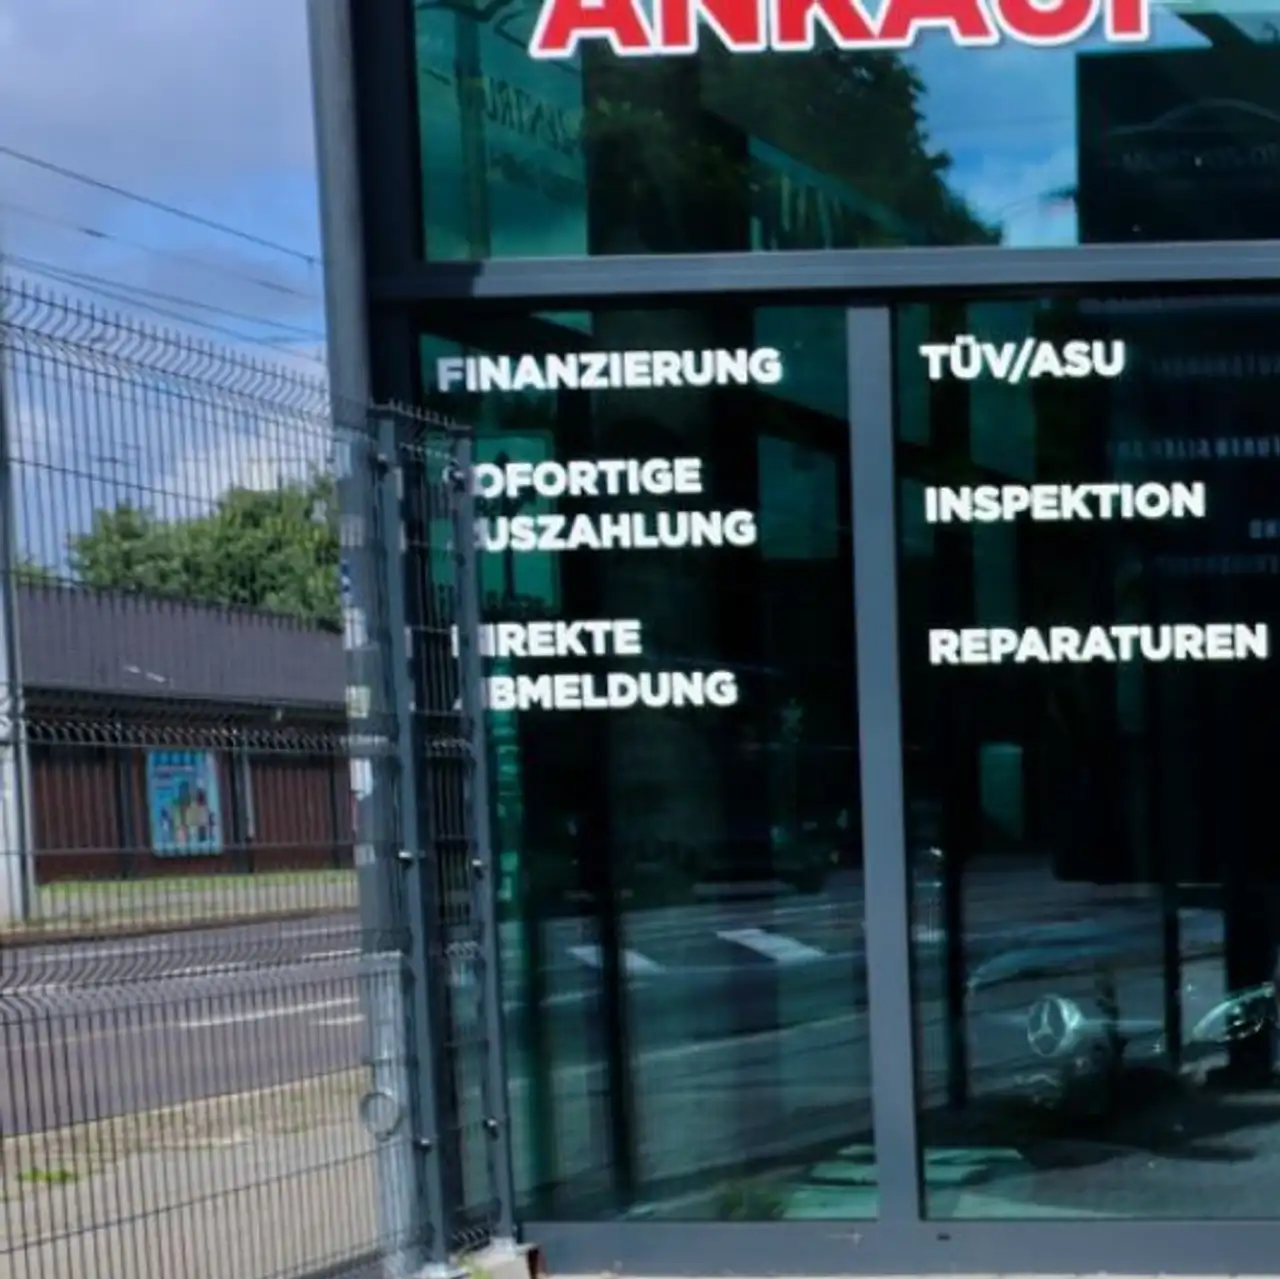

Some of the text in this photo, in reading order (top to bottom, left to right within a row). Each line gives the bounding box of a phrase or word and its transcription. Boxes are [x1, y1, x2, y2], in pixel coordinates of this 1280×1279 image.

[437, 346, 784, 393] FINANZIERUNG
[919, 334, 1126, 384] TÜV/ASU
[444, 456, 704, 500] OFORTIGE
[924, 481, 1206, 523] INSPEKTION
[452, 618, 643, 658] IREKTE
[928, 622, 1269, 665] REPARATUREN
